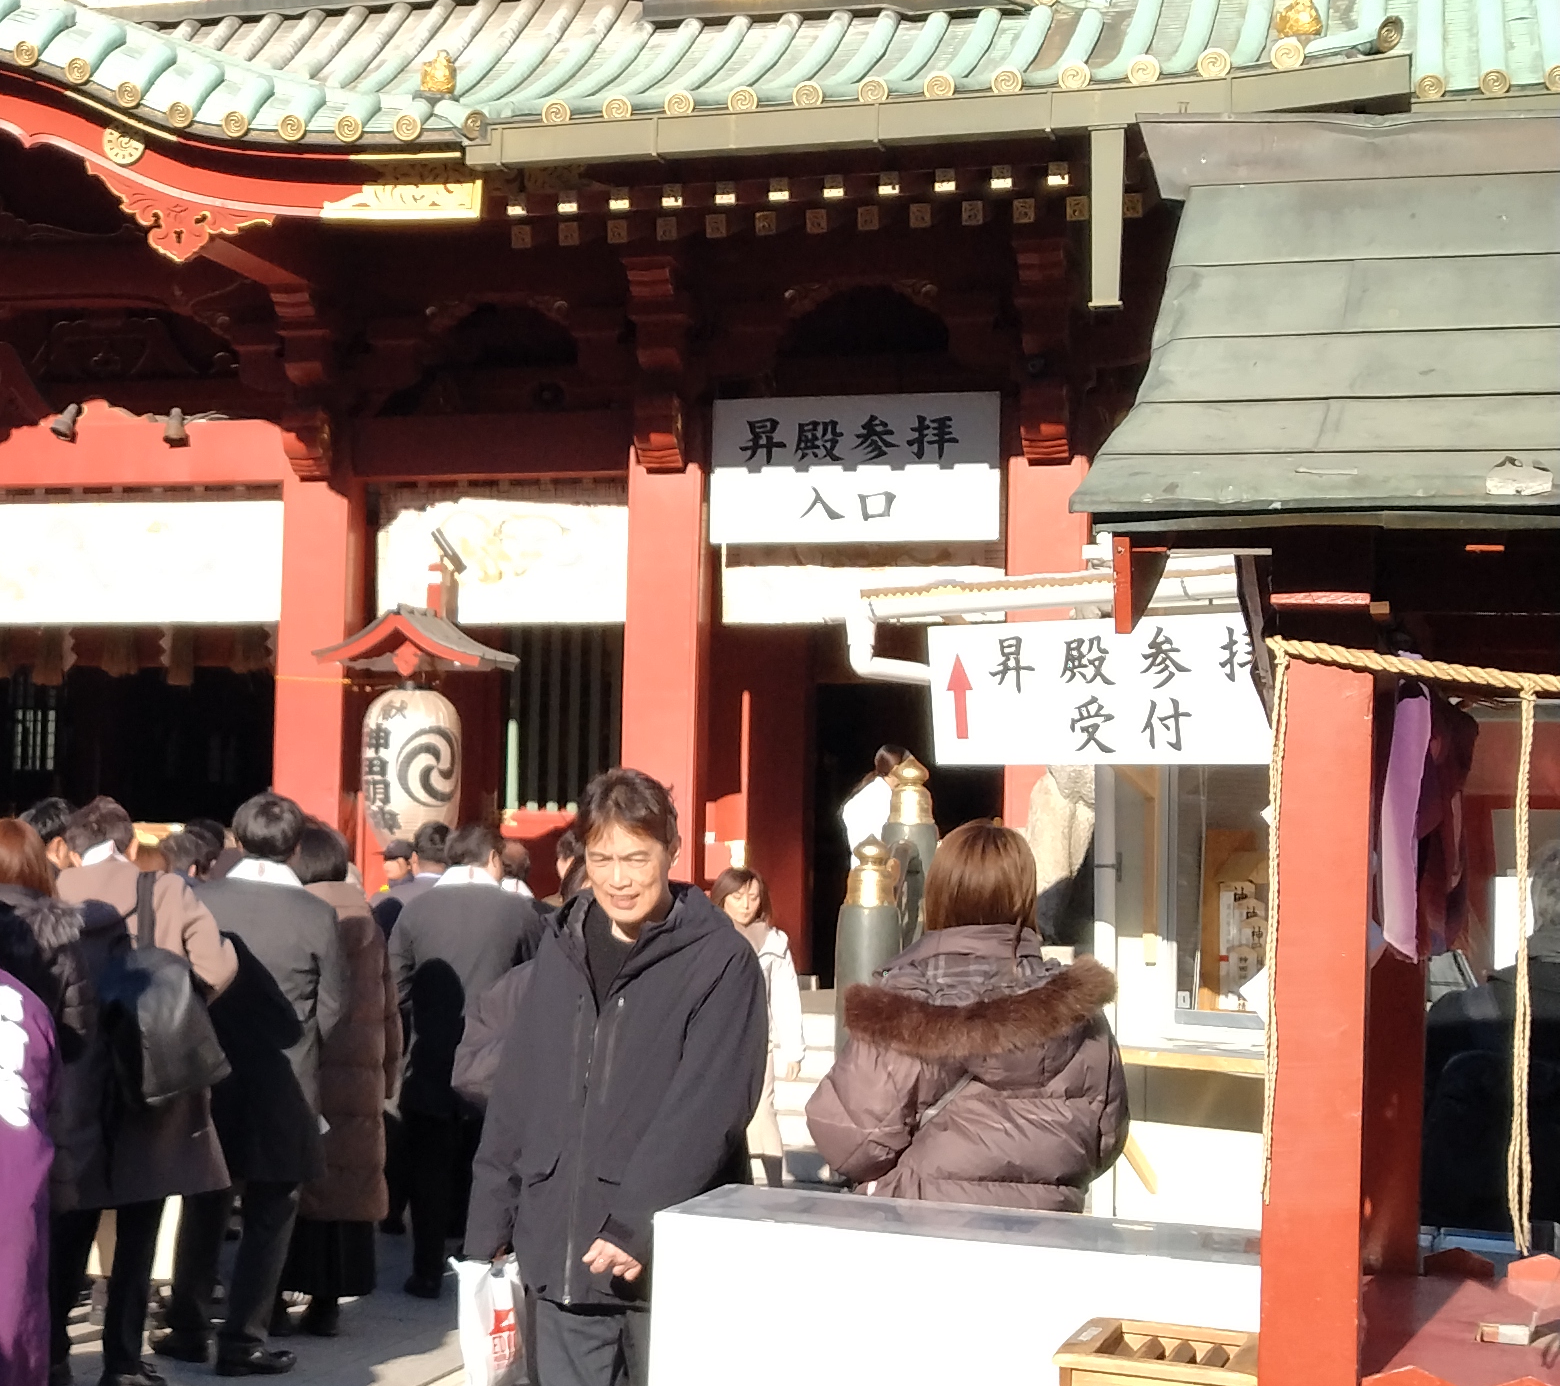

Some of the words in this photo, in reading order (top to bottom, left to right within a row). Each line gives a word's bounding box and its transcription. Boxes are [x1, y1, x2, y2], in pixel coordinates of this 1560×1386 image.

[739, 414, 960, 464] 昇殿参拝
[799, 485, 897, 522] 入口
[1068, 694, 1193, 754] 受付
